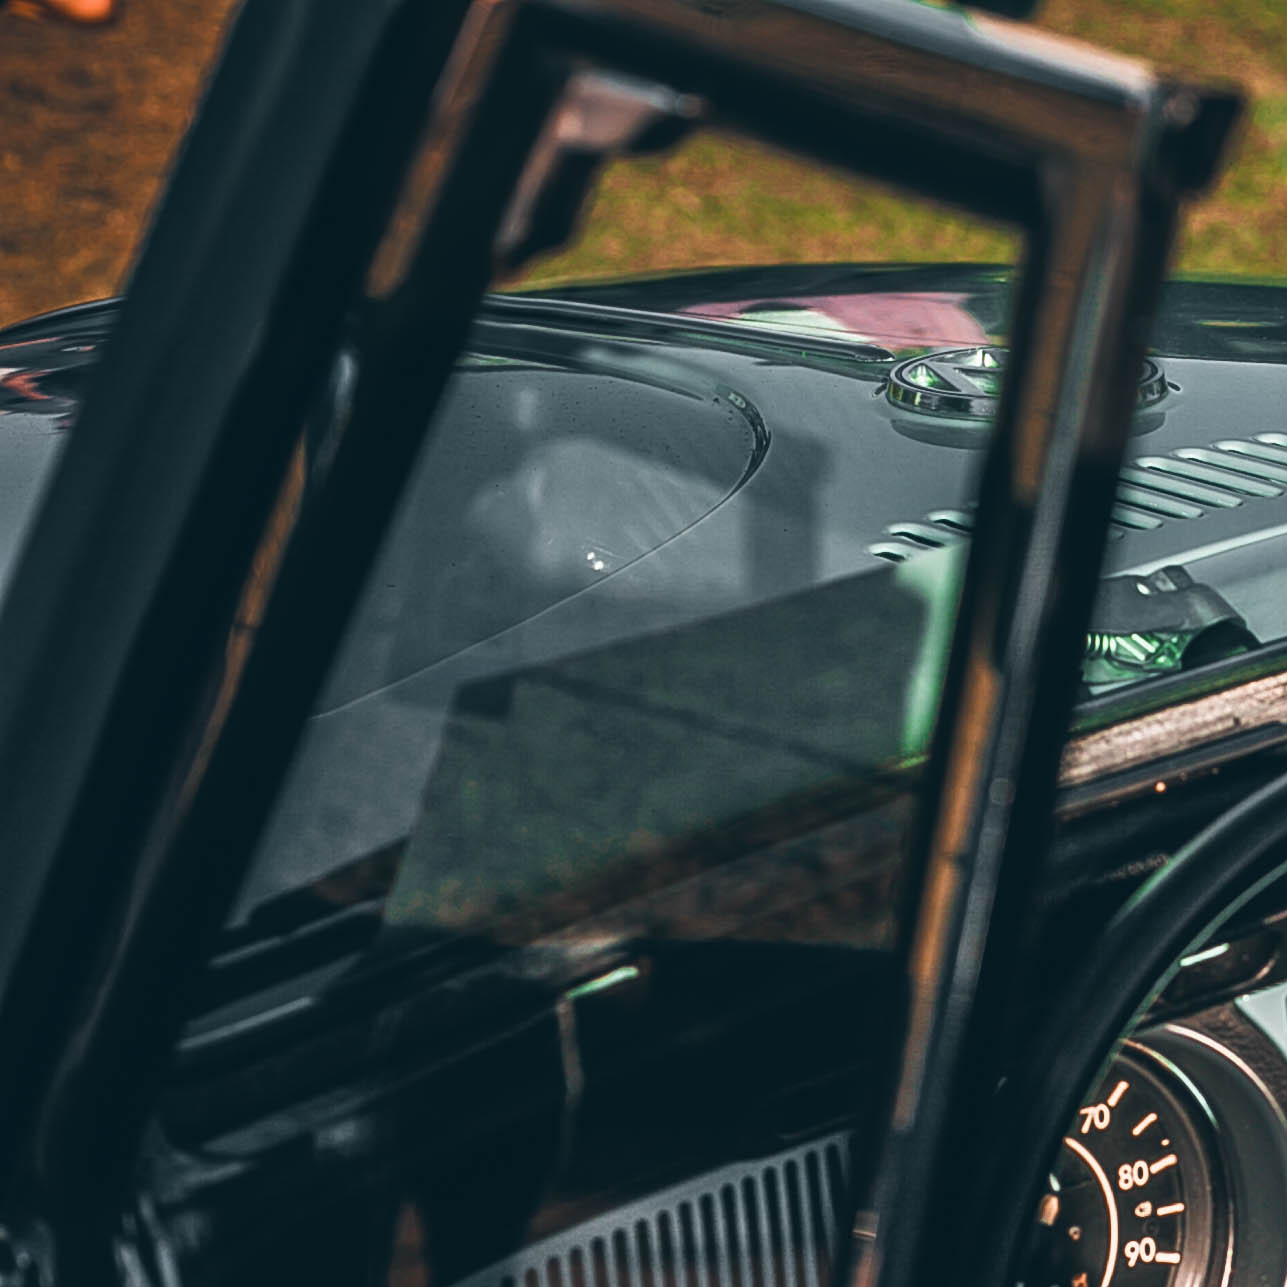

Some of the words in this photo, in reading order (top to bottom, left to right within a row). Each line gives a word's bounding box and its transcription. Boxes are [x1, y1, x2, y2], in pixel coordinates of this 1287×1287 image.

[1080, 1103, 1110, 1134] 70
[1118, 1160, 1149, 1190] 80
[1124, 1236, 1156, 1267] 90
